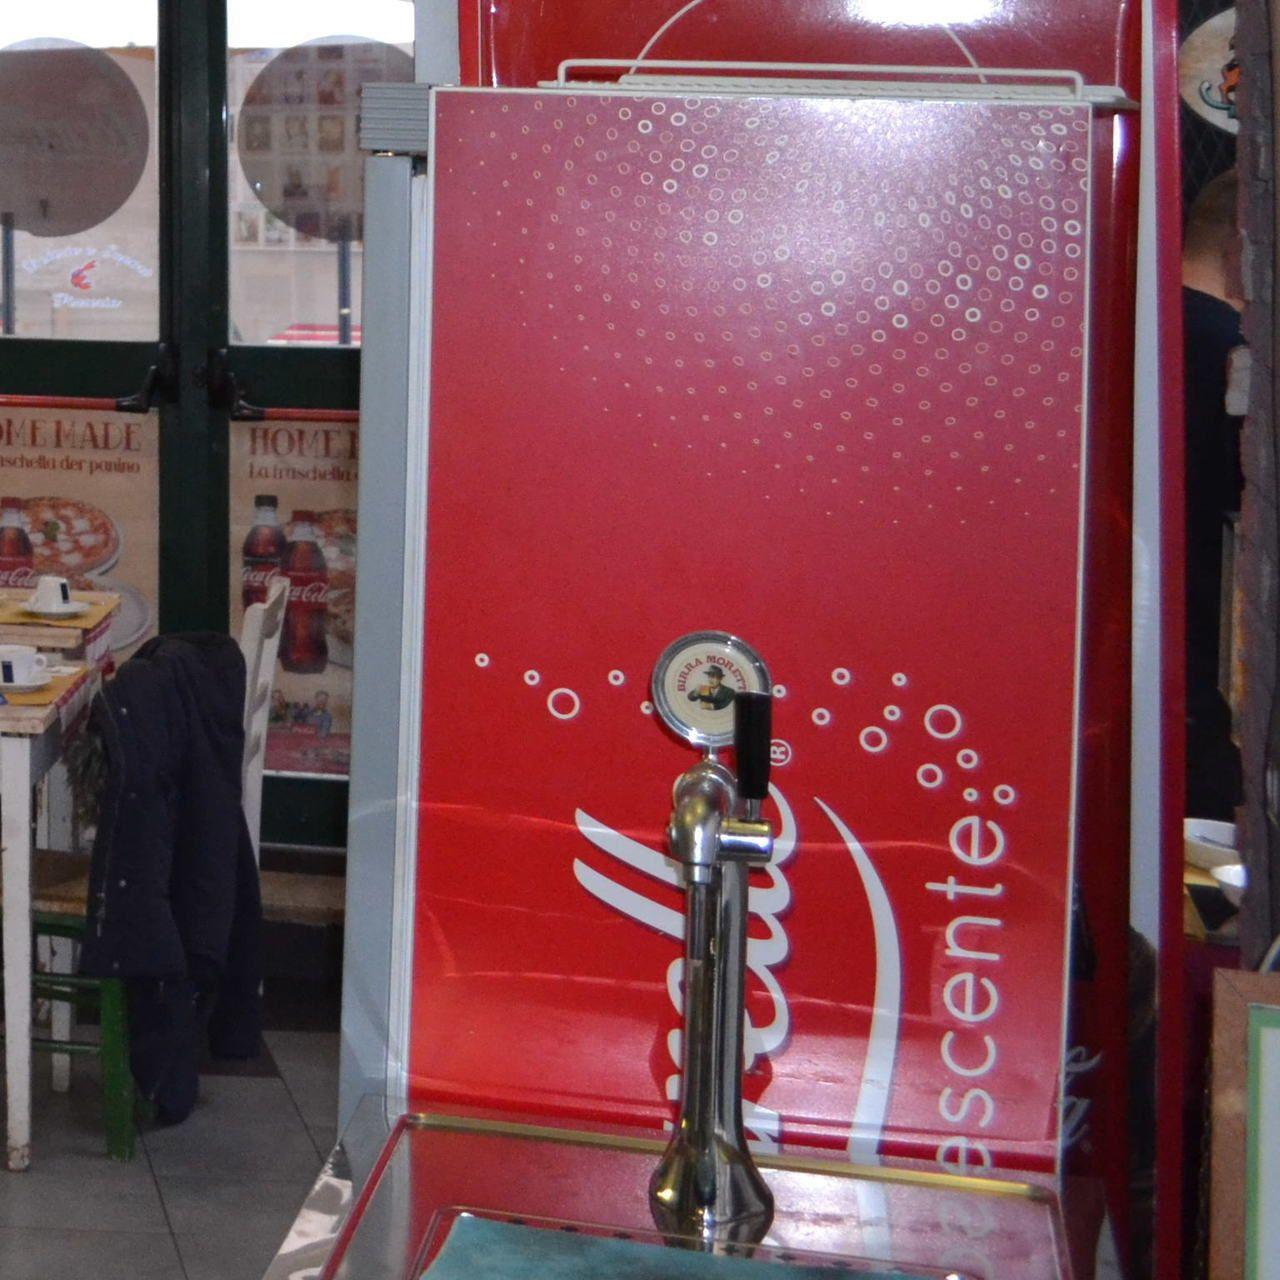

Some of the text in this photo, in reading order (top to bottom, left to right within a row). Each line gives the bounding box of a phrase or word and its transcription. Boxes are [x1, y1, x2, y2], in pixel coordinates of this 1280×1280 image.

[54, 419, 140, 452] MADE
[249, 427, 340, 459] HOME
[60, 456, 85, 471] der
[89, 458, 140, 475] panino
[677, 654, 747, 692] BIRRA MORETT
